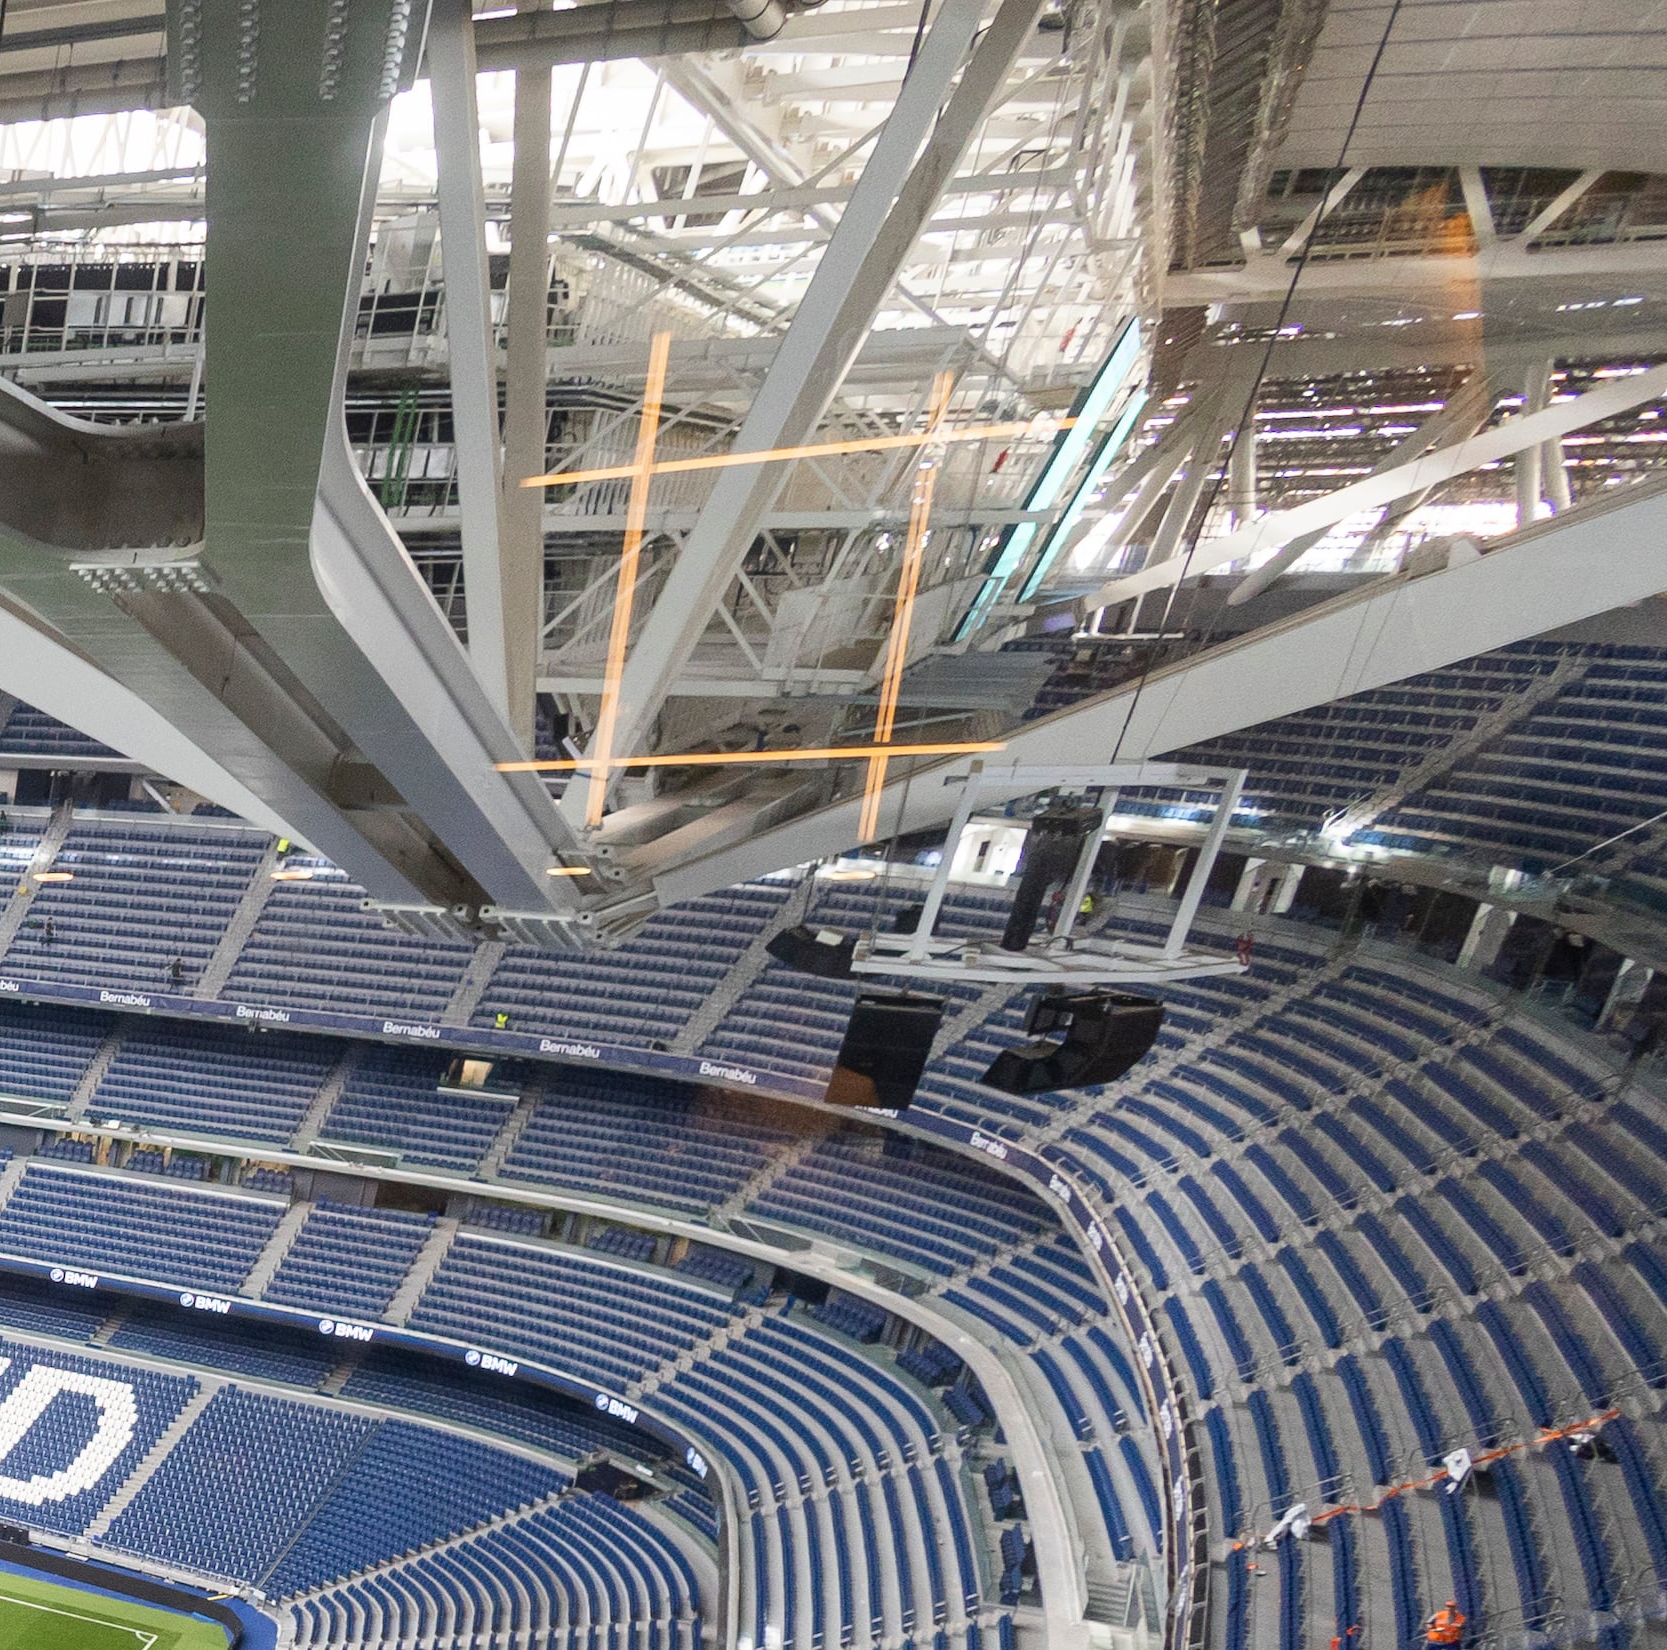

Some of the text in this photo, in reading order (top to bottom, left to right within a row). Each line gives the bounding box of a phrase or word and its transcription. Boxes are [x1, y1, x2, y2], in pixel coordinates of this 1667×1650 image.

[100, 991, 150, 1007] Bernabéu
[236, 1005, 289, 1022] Bernabéu
[383, 1022, 440, 1038] Bernabéu
[540, 1039, 600, 1058] Bernabéu
[699, 1062, 756, 1084] Bernabéu
[63, 1271, 98, 1288] BMW
[194, 1297, 230, 1313] BMW
[334, 1323, 373, 1342] BMW
[480, 1354, 518, 1376] BMW
[607, 1399, 638, 1423] BMW
